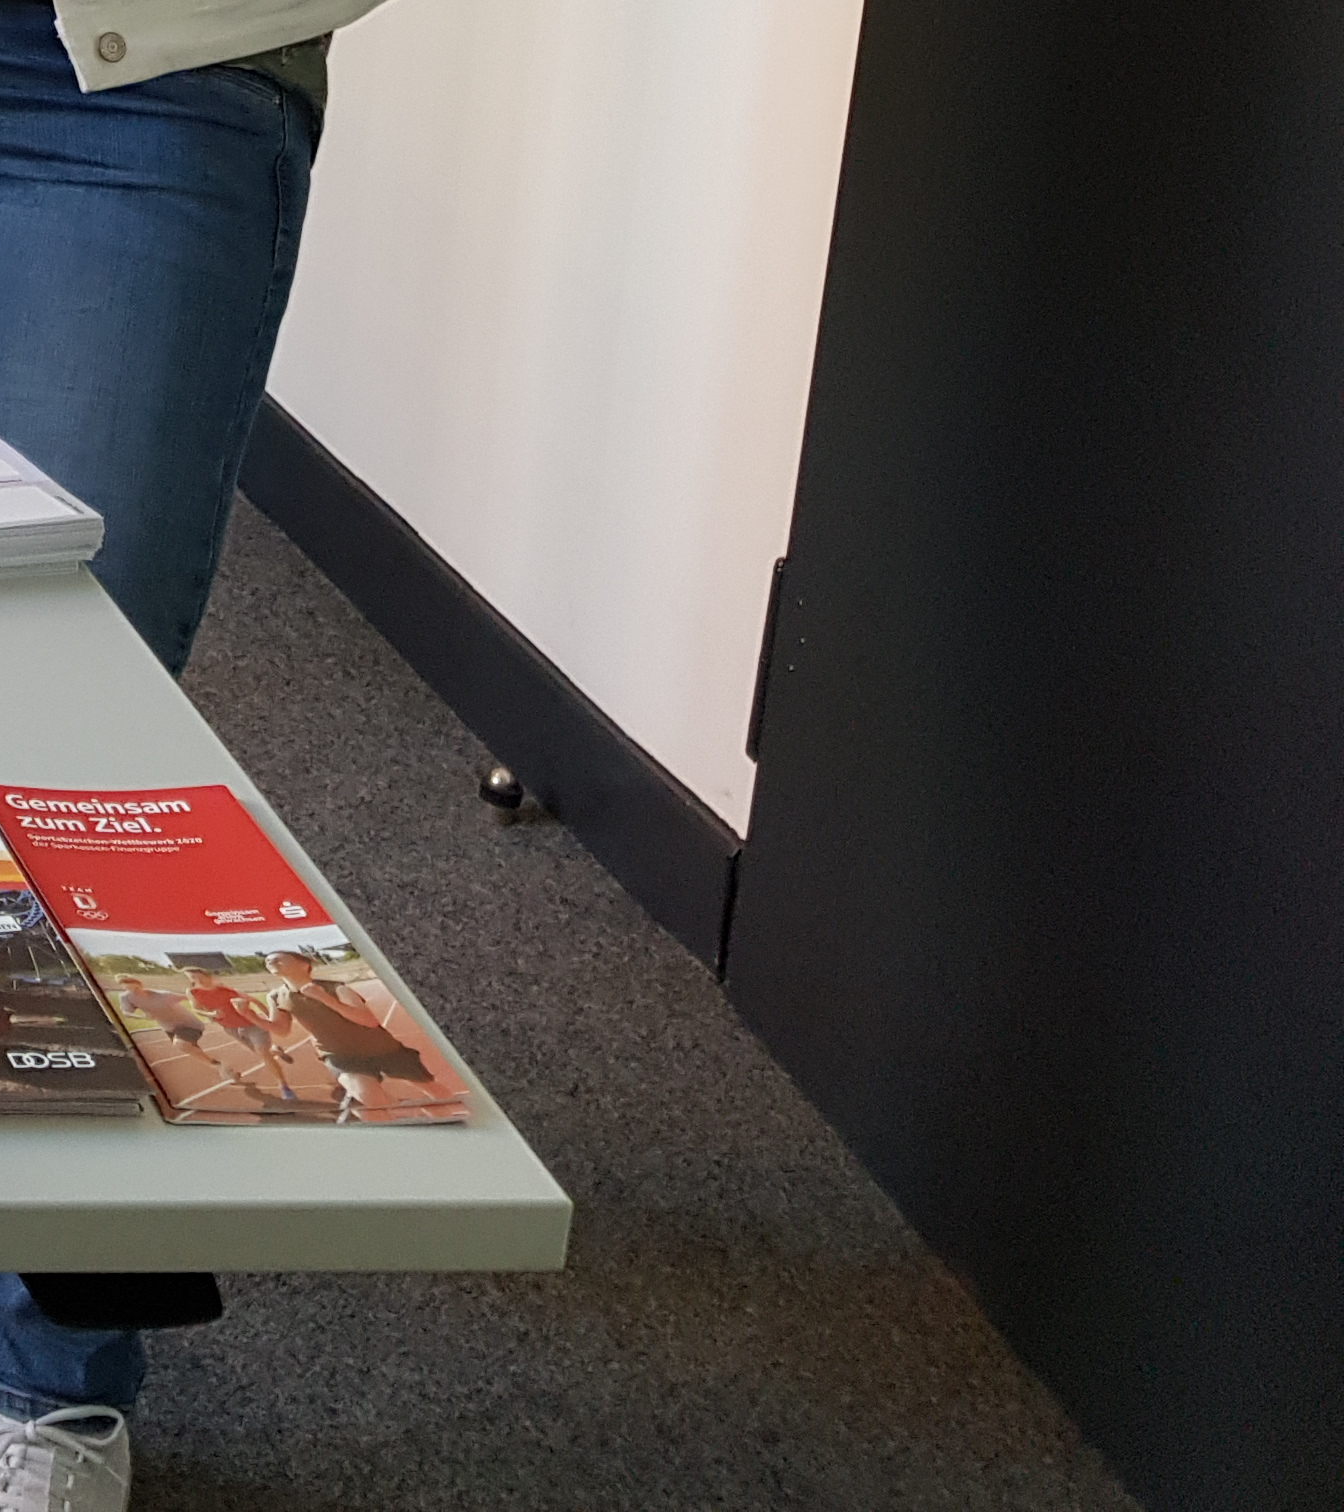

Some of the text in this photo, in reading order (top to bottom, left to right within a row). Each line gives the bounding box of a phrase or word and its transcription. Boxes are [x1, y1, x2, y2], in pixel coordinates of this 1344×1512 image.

[4, 793, 192, 816] Gemeinsam
[16, 814, 163, 834] zum Ziel.
[60, 884, 94, 894] TEAM
[6, 1051, 97, 1069] DOSB
